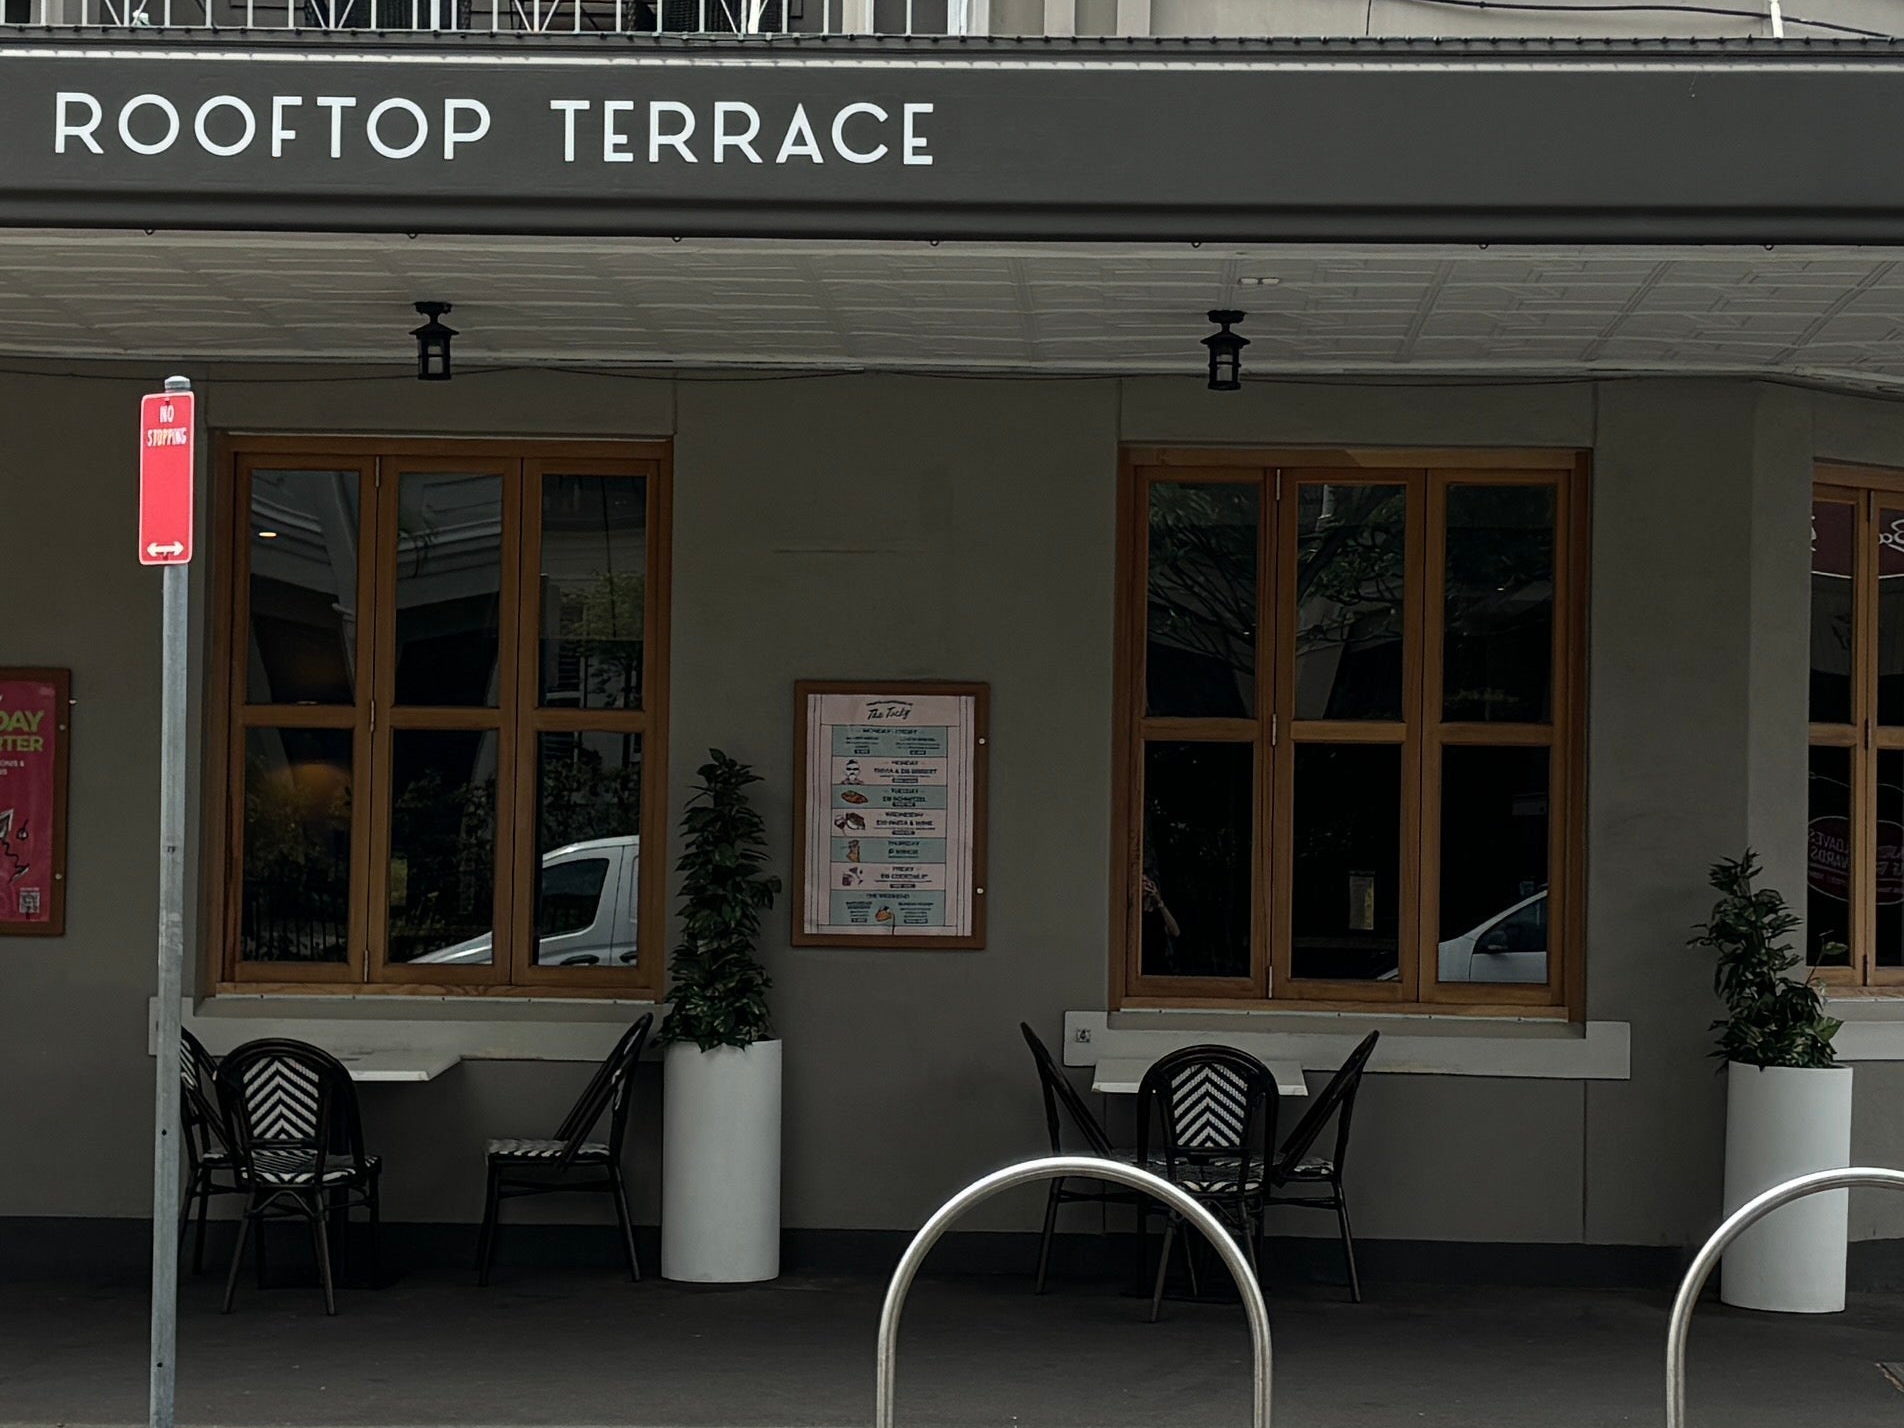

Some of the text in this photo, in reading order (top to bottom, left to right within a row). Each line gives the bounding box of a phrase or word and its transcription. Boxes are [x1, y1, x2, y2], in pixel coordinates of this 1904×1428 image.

[55, 92, 934, 166] ROOFTOP TERRACE
[159, 405, 175, 423] NO
[147, 427, 187, 447] STOPPING
